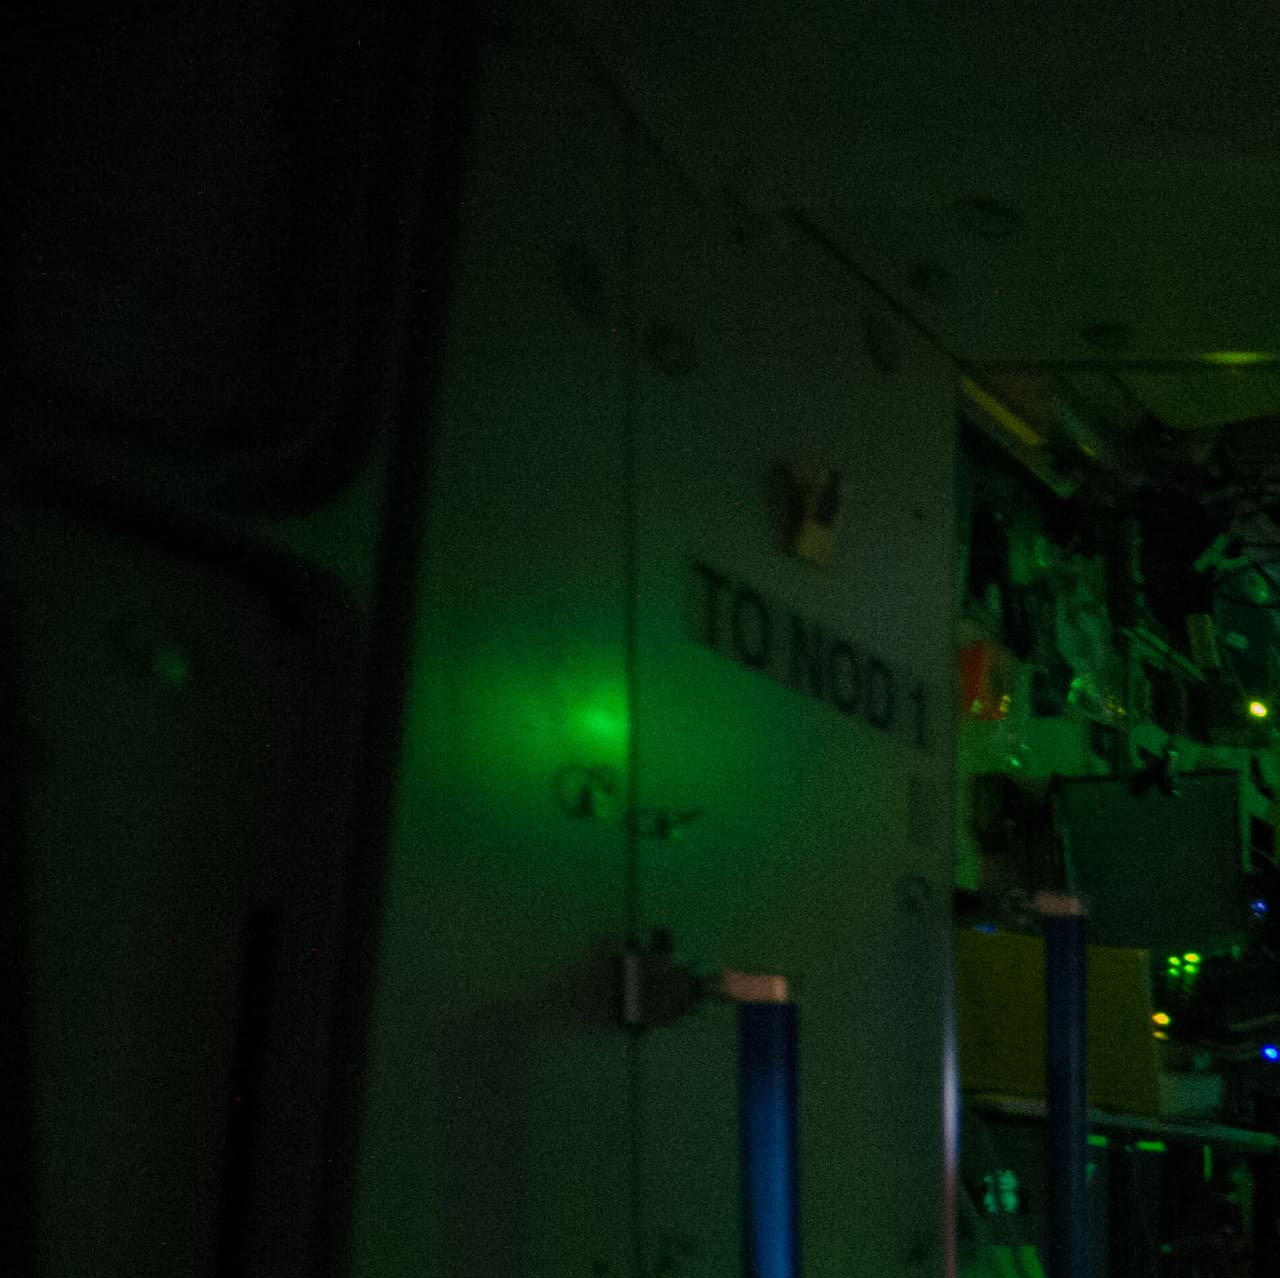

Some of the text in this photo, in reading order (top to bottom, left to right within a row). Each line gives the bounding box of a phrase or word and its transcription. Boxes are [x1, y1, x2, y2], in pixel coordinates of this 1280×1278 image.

[692, 561, 928, 747] TO NOD 1
